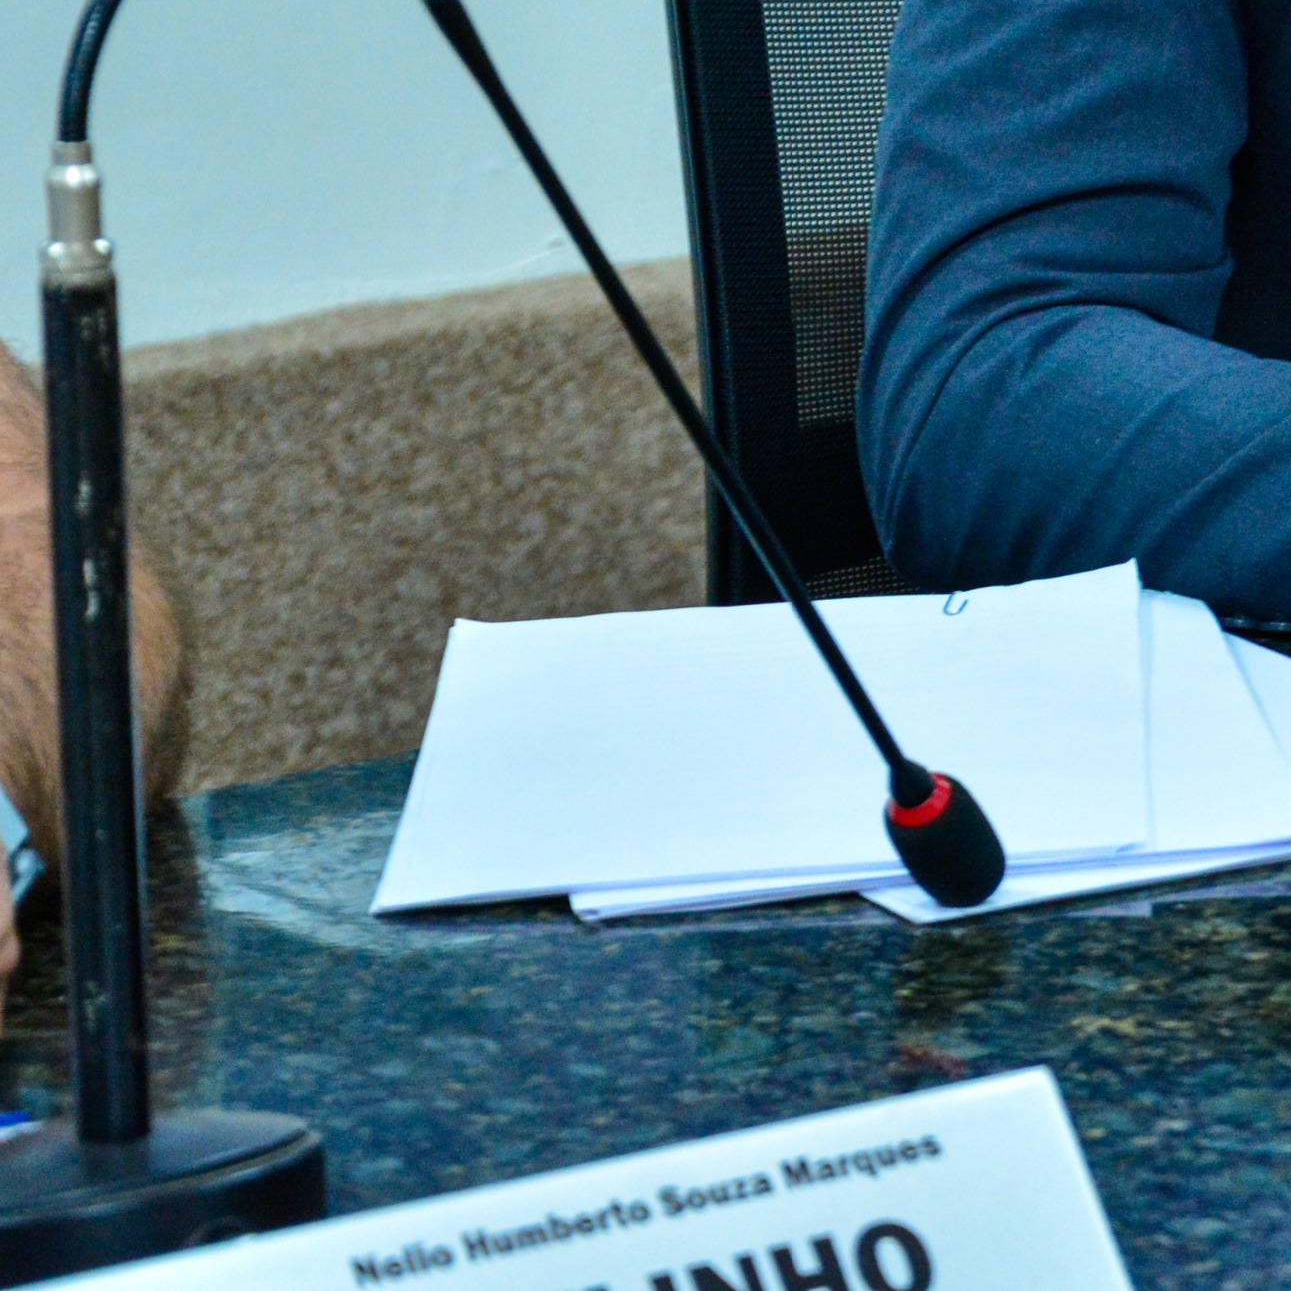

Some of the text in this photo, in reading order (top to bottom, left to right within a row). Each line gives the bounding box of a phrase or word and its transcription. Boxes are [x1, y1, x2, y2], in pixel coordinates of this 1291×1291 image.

[462, 1199, 650, 1260] Humberto
[658, 1174, 772, 1216] Souza
[781, 1134, 941, 1188] Marques
